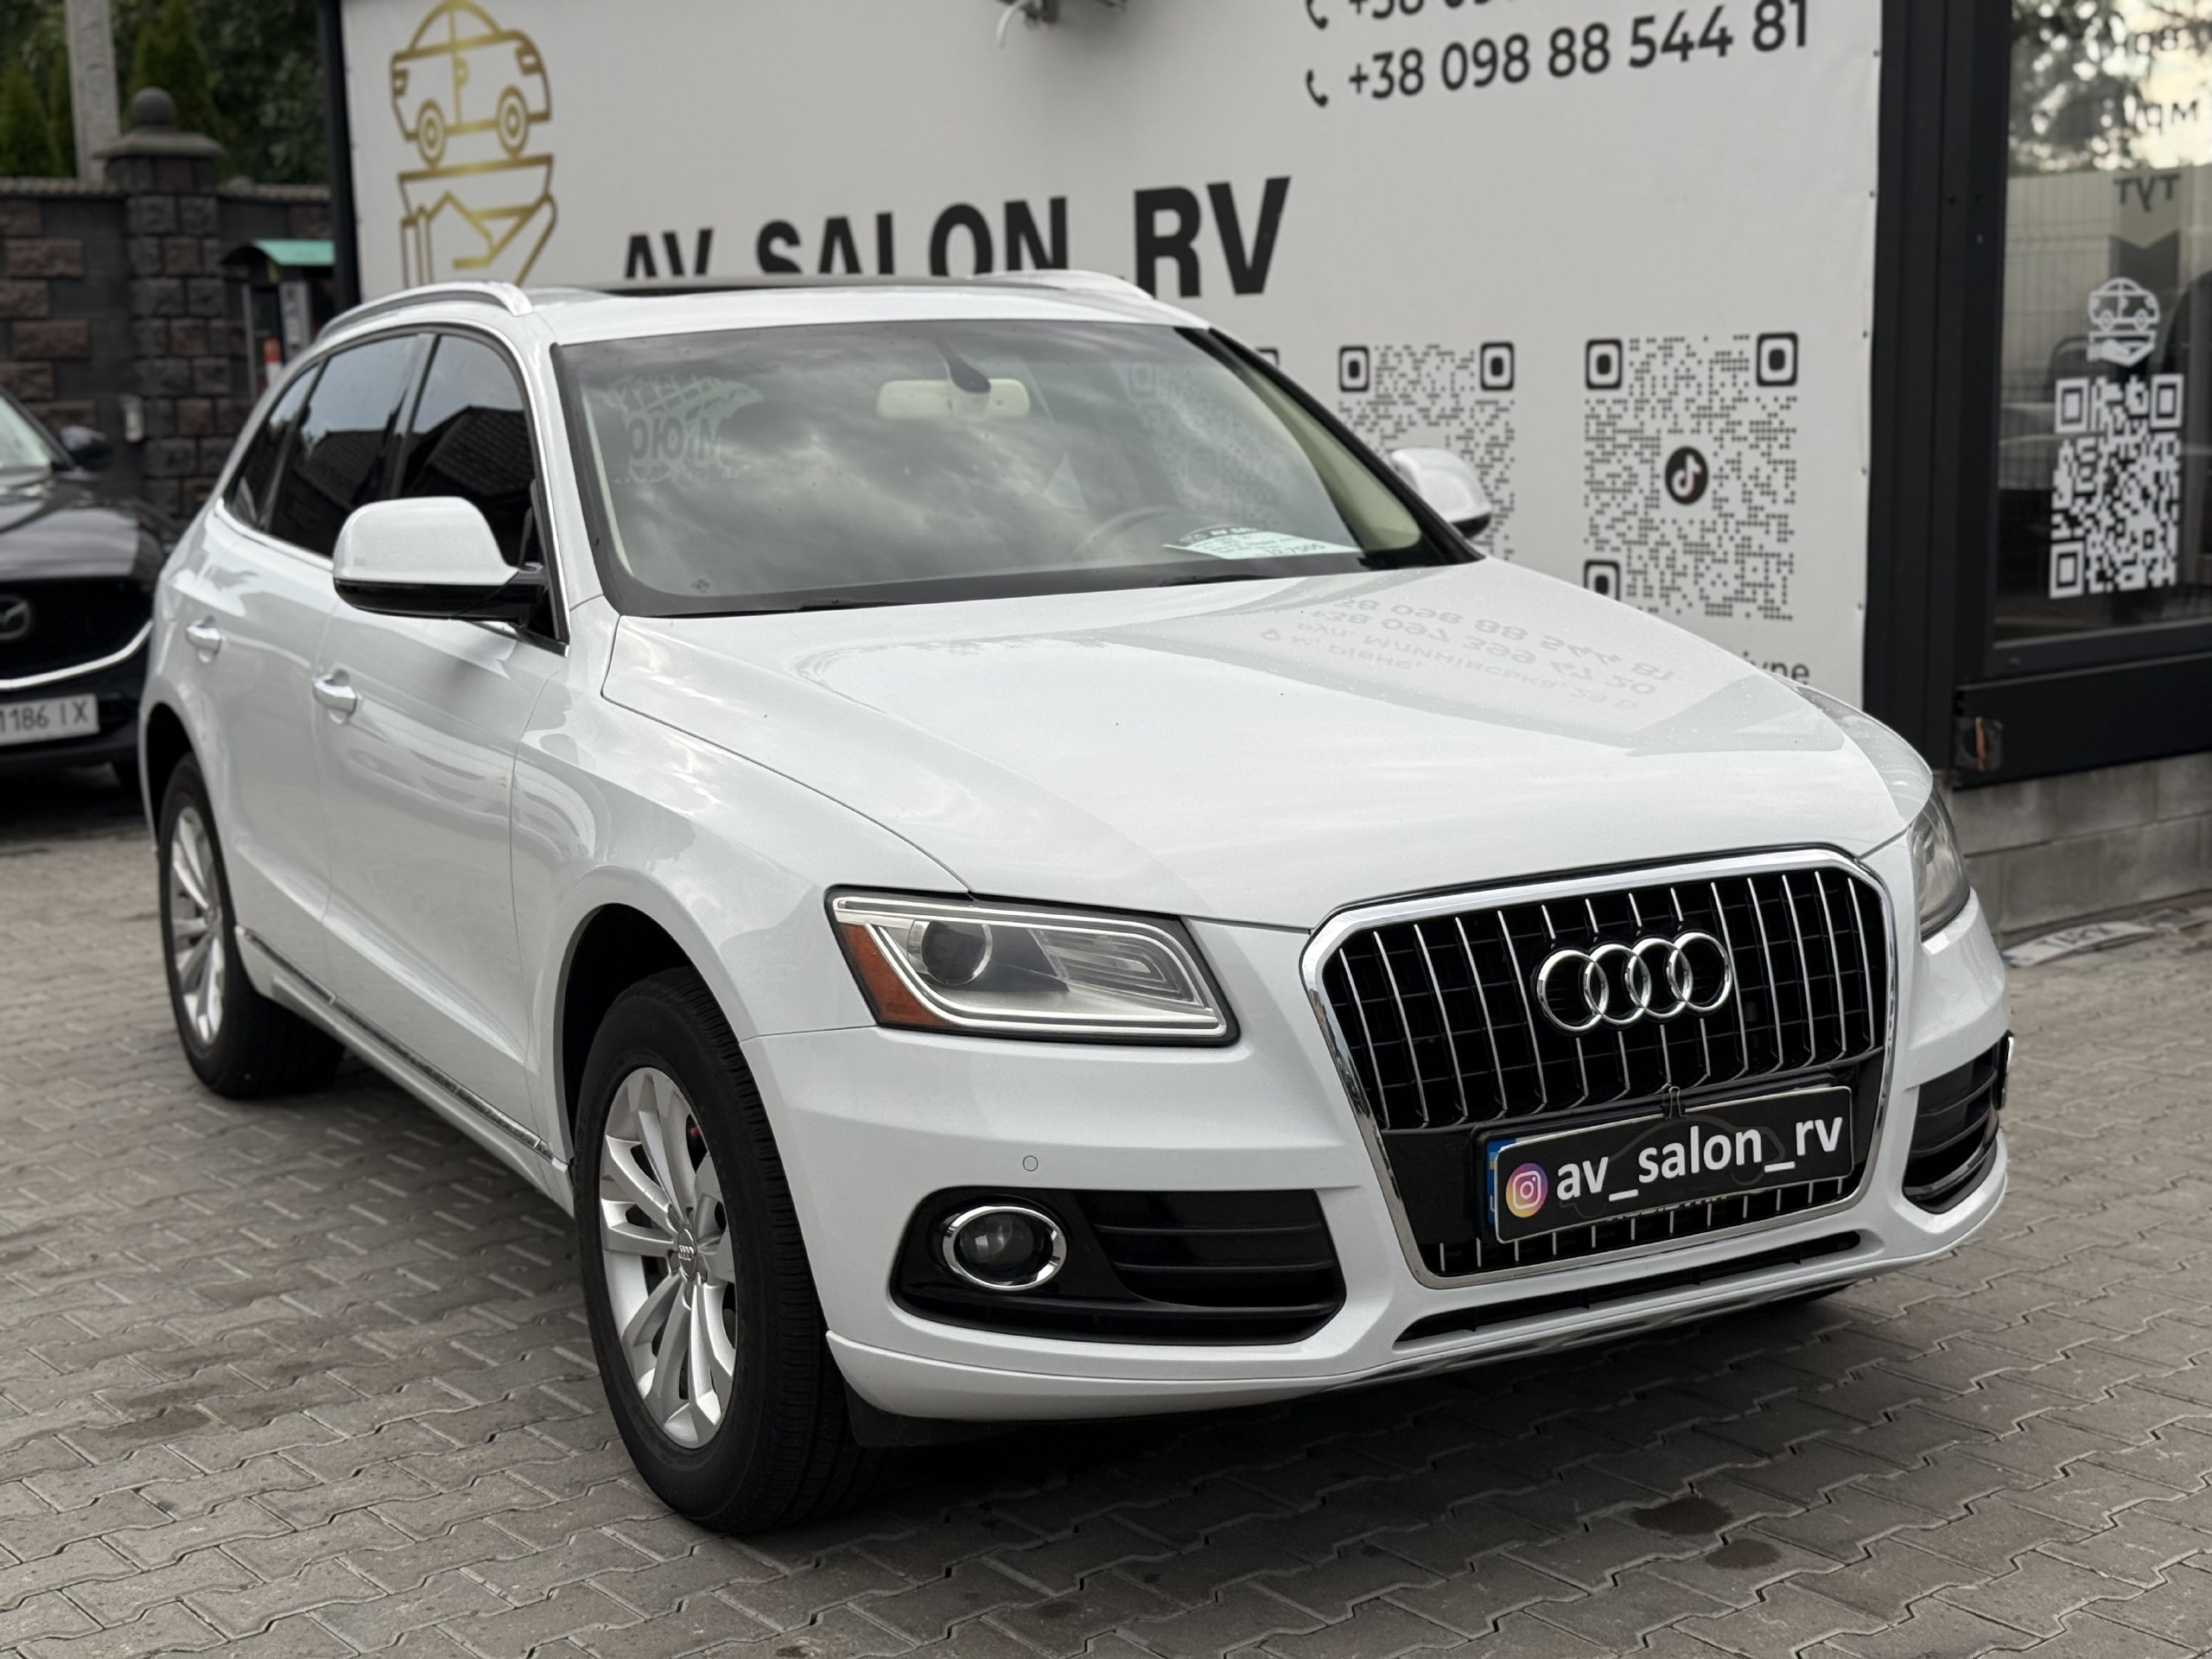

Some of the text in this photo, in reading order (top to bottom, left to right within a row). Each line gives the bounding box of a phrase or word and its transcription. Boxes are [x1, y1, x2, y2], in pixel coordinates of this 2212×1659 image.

[1349, 0, 1806, 99] +38 098 88 544 81
[1134, 176, 1290, 299] RV
[1556, 1116, 1843, 1203] av_salon_rv
